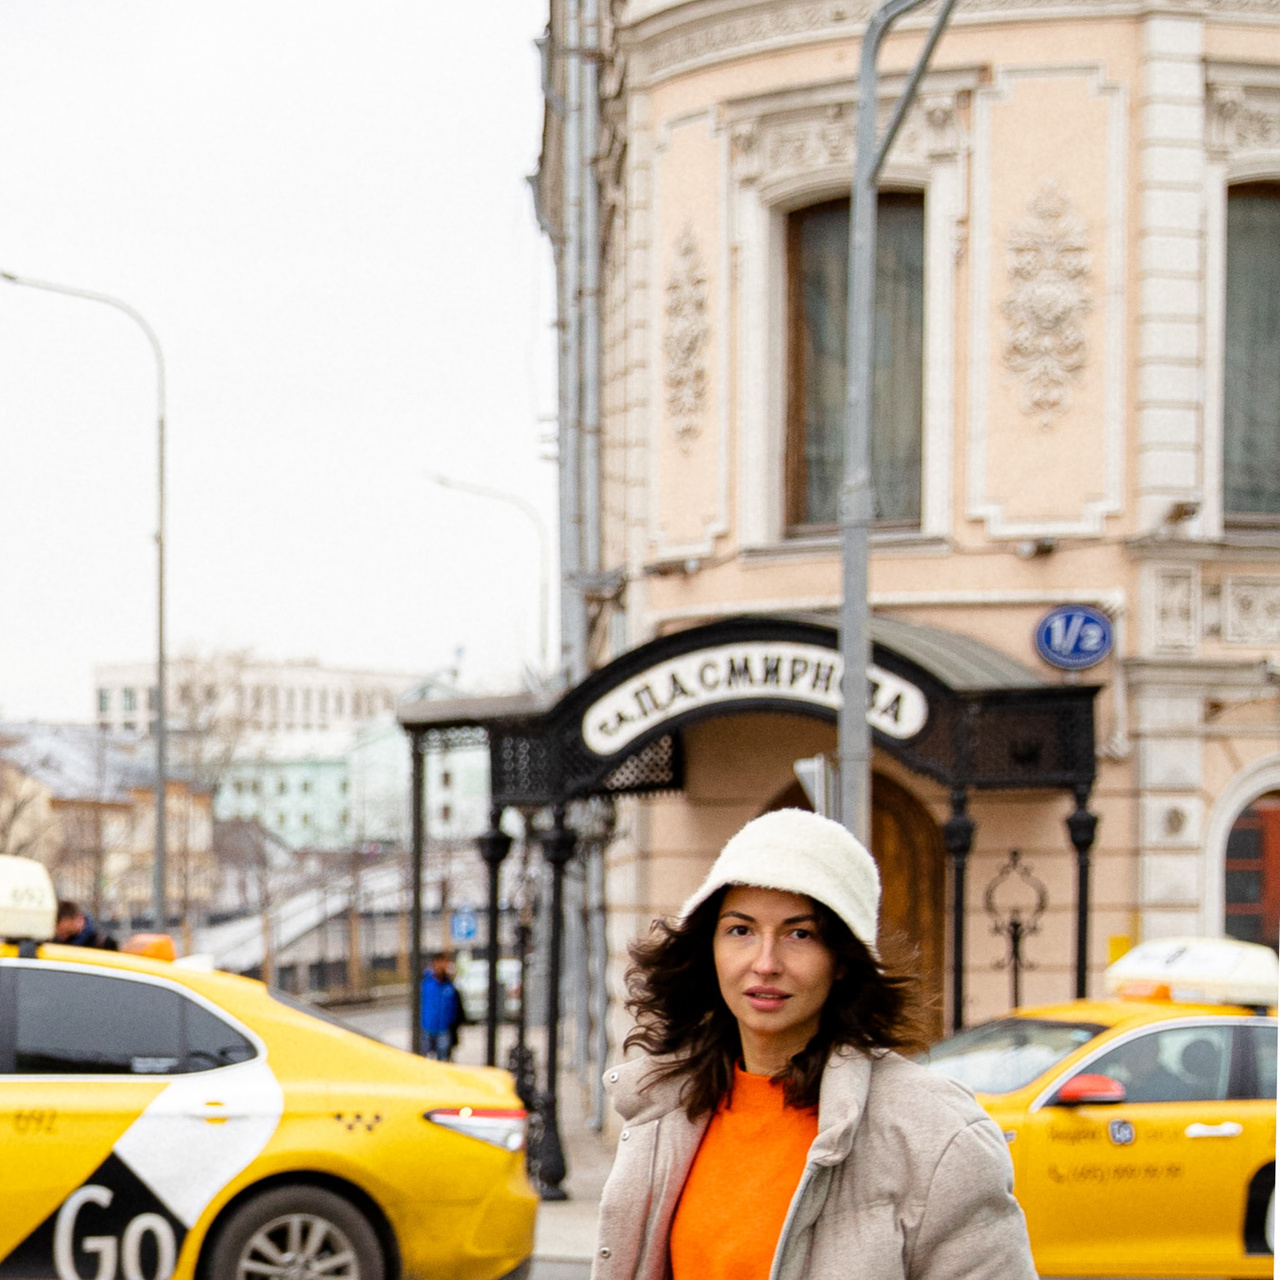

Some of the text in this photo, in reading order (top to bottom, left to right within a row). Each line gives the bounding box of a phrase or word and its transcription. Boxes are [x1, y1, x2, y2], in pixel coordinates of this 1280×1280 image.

[1050, 612, 1104, 655] 1/2
[699, 655, 903, 723] СМИРНВА
[13, 1108, 58, 1136] 692
